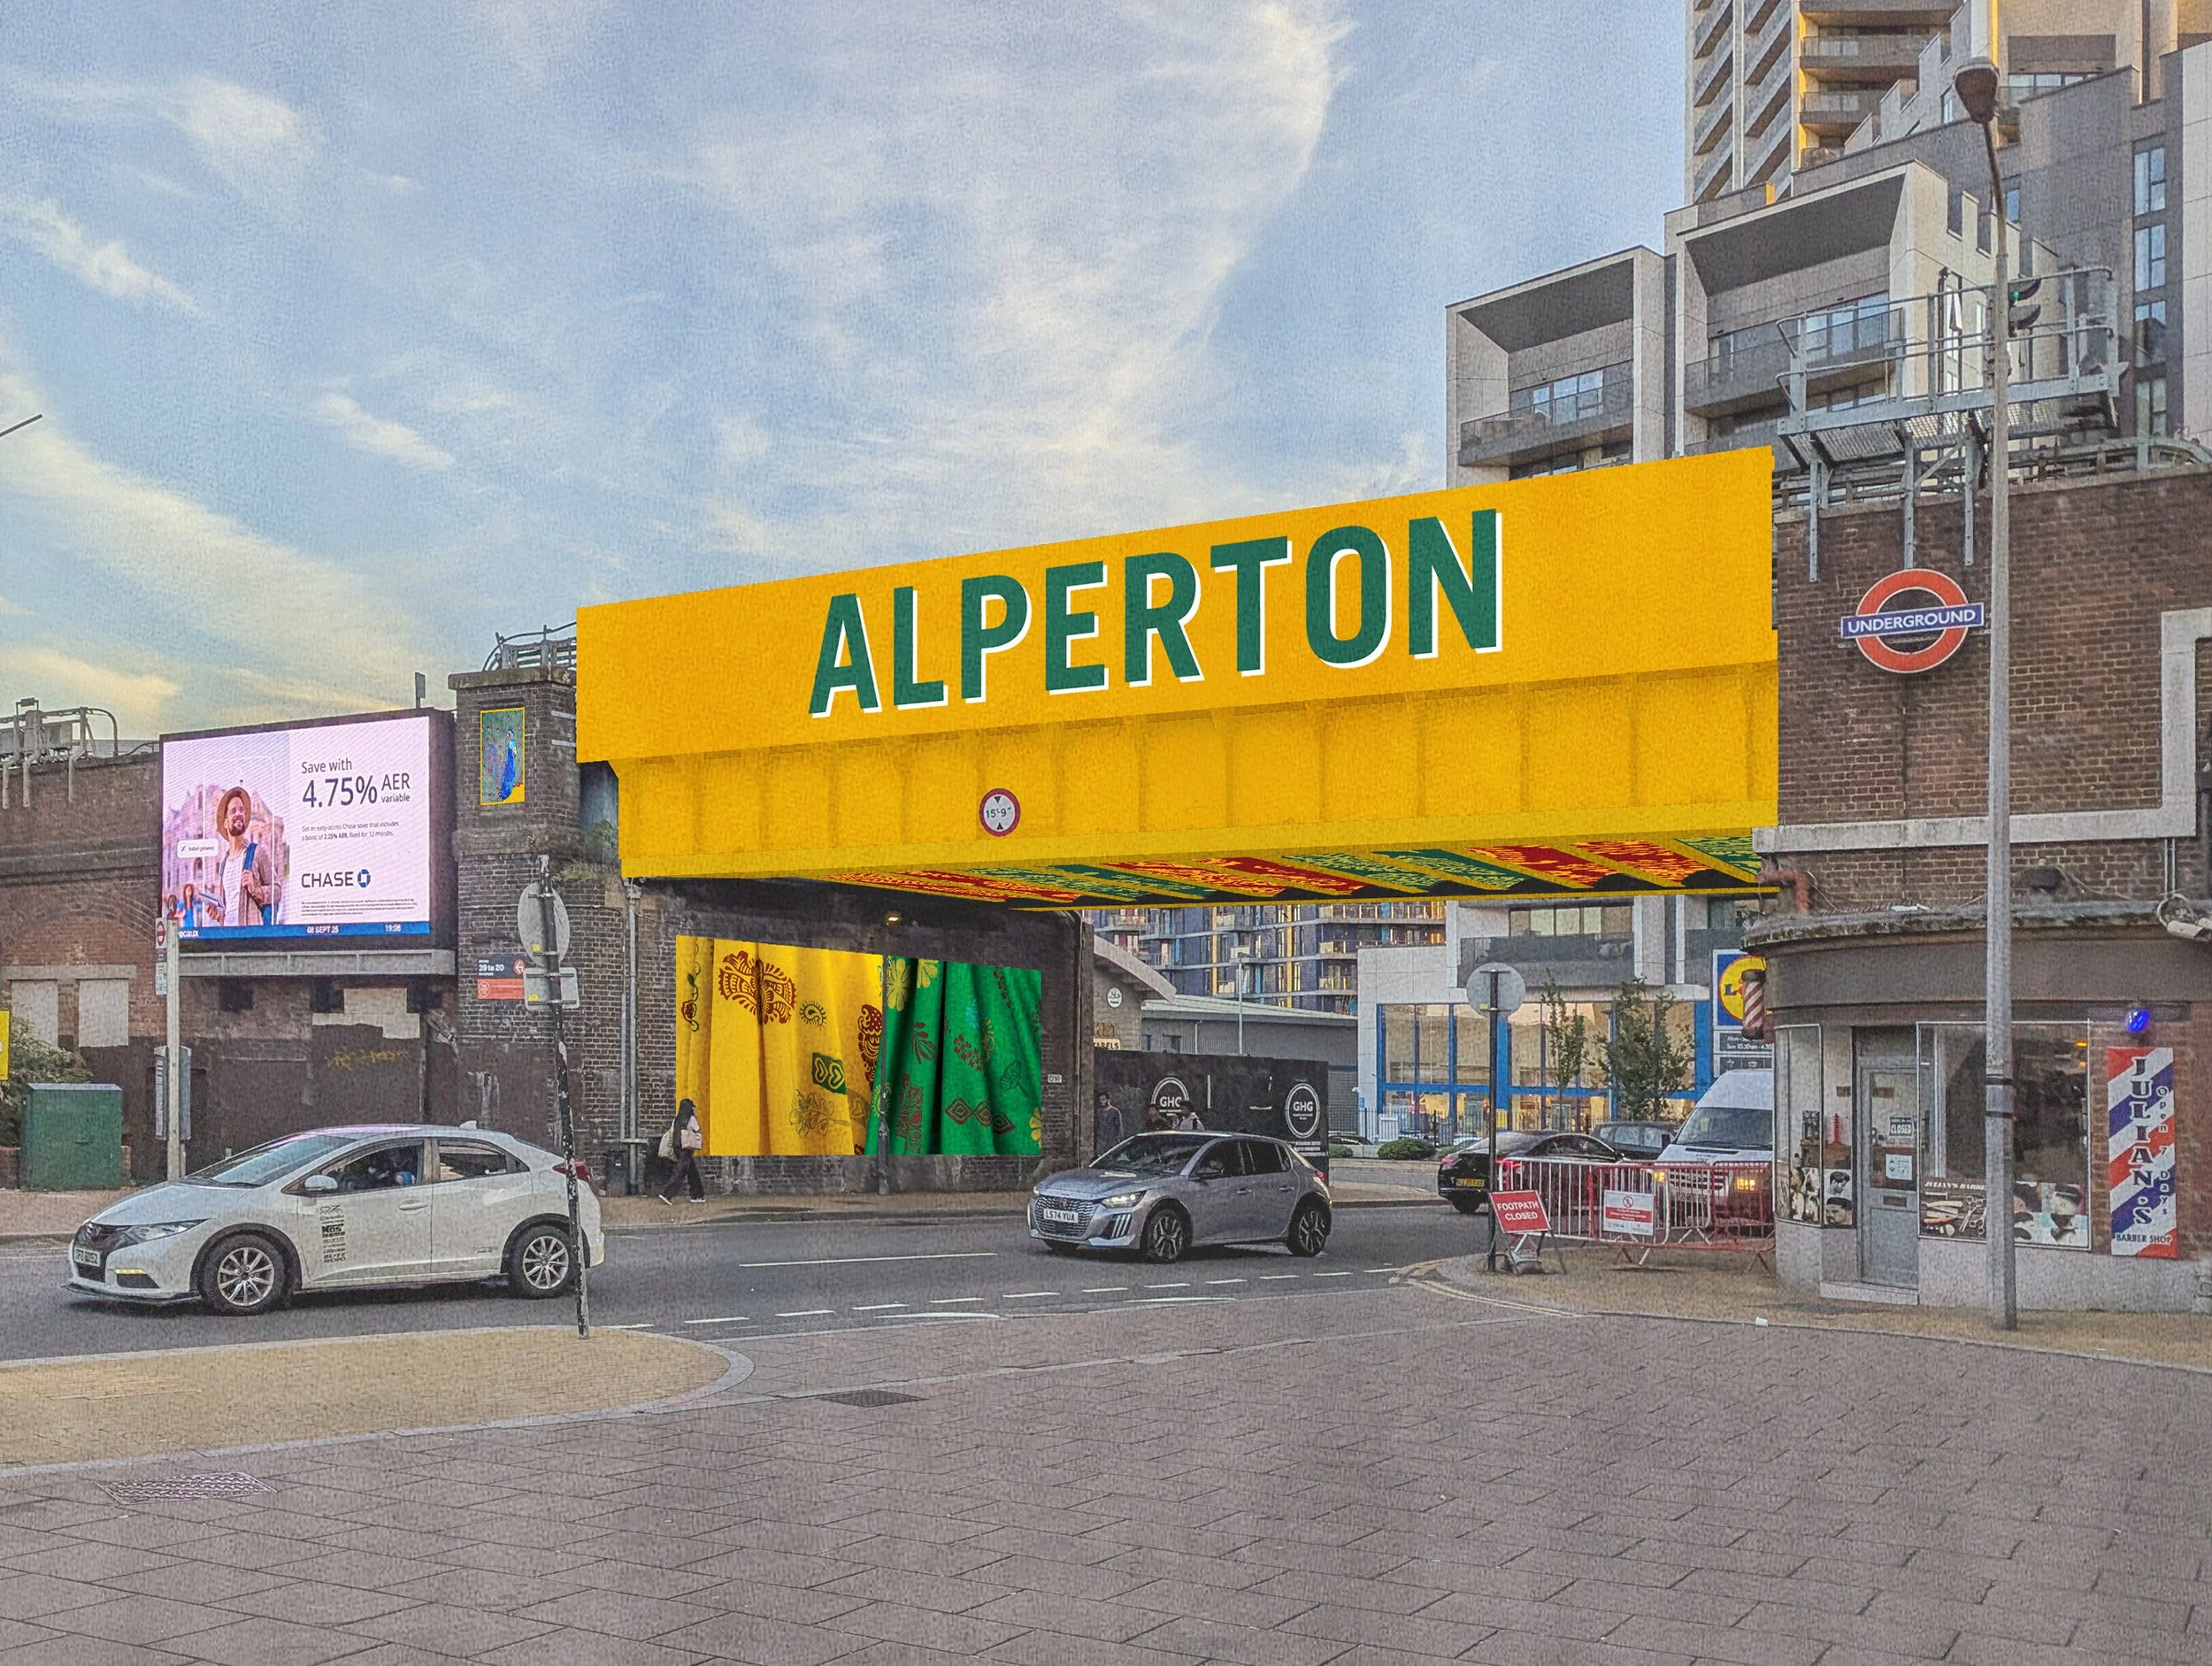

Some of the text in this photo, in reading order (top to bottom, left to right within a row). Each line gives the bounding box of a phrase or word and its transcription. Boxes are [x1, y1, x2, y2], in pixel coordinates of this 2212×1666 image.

[808, 508, 1503, 719] ALPERTON
[1847, 609, 1977, 633] UNDERGROUND
[301, 757, 352, 774] Save with
[302, 772, 411, 808] 4.75% AER
[380, 793, 411, 803] variable
[301, 871, 354, 888] CHASE
[1293, 1101, 1313, 1112] GHG
[1890, 1124, 1912, 1134] CLOSED
[1496, 1201, 1540, 1211] FOOTPATH
[1045, 1209, 1075, 1221] LS74 YUA
[1505, 1211, 1539, 1221] CLOSED
[2116, 1233, 2172, 1244] BARBER SHOP
